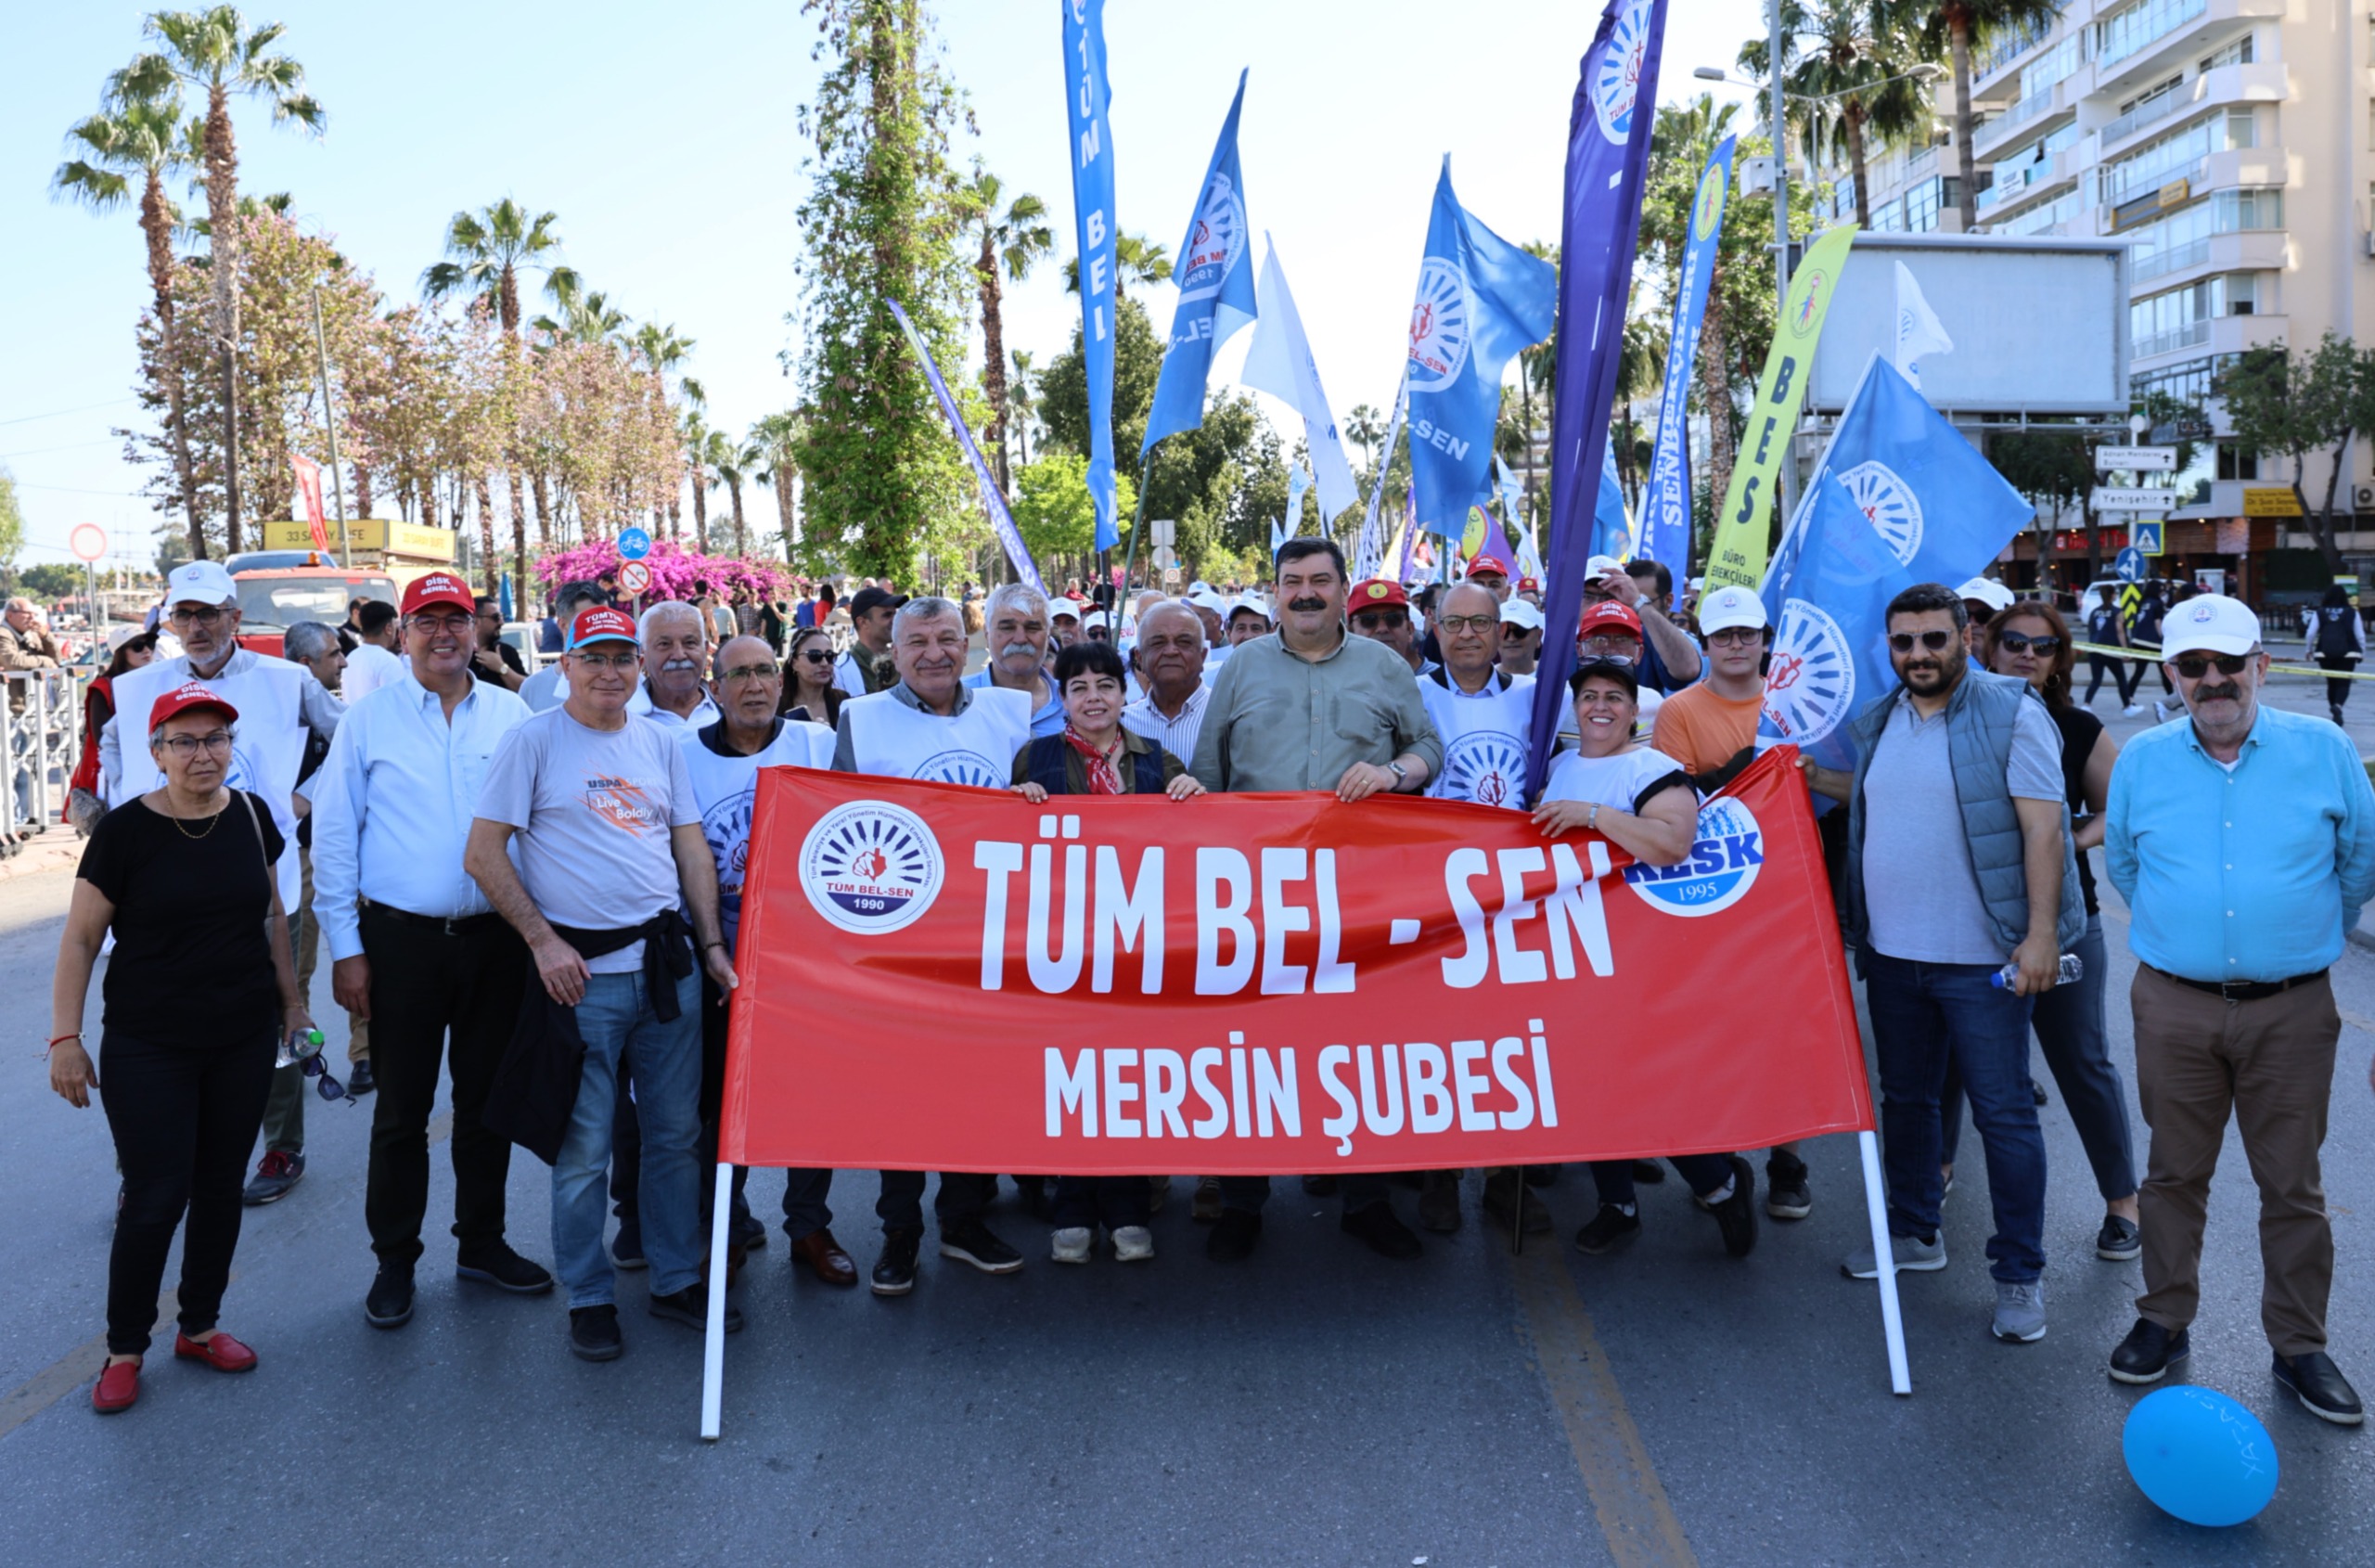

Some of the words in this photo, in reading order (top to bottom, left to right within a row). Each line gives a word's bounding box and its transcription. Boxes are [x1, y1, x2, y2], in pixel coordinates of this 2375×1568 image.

[1408, 347, 1447, 375] EL-SEN
[1736, 355, 1796, 524] BES
[2102, 494, 2159, 504] Yenişehir
[425, 576, 451, 586] DİSK
[587, 779, 623, 789] USPA
[597, 796, 622, 809] Live
[615, 807, 654, 819] Boldly
[830, 816, 848, 830] Yerel
[847, 810, 877, 819] Yönetim
[877, 810, 911, 829] Hizmetleri
[909, 826, 931, 860] Emekçileri
[826, 881, 855, 893] TÜM
[858, 885, 915, 898] BEL-SEN
[1677, 881, 1718, 901] 1995
[854, 898, 885, 910] 1990
[974, 814, 1165, 996] TÜM
[1195, 846, 1356, 996] BEL
[1441, 842, 1614, 989] SEN
[1044, 1031, 1302, 1138] MERSİN
[1317, 1019, 1559, 1157] ŞUBESİ
